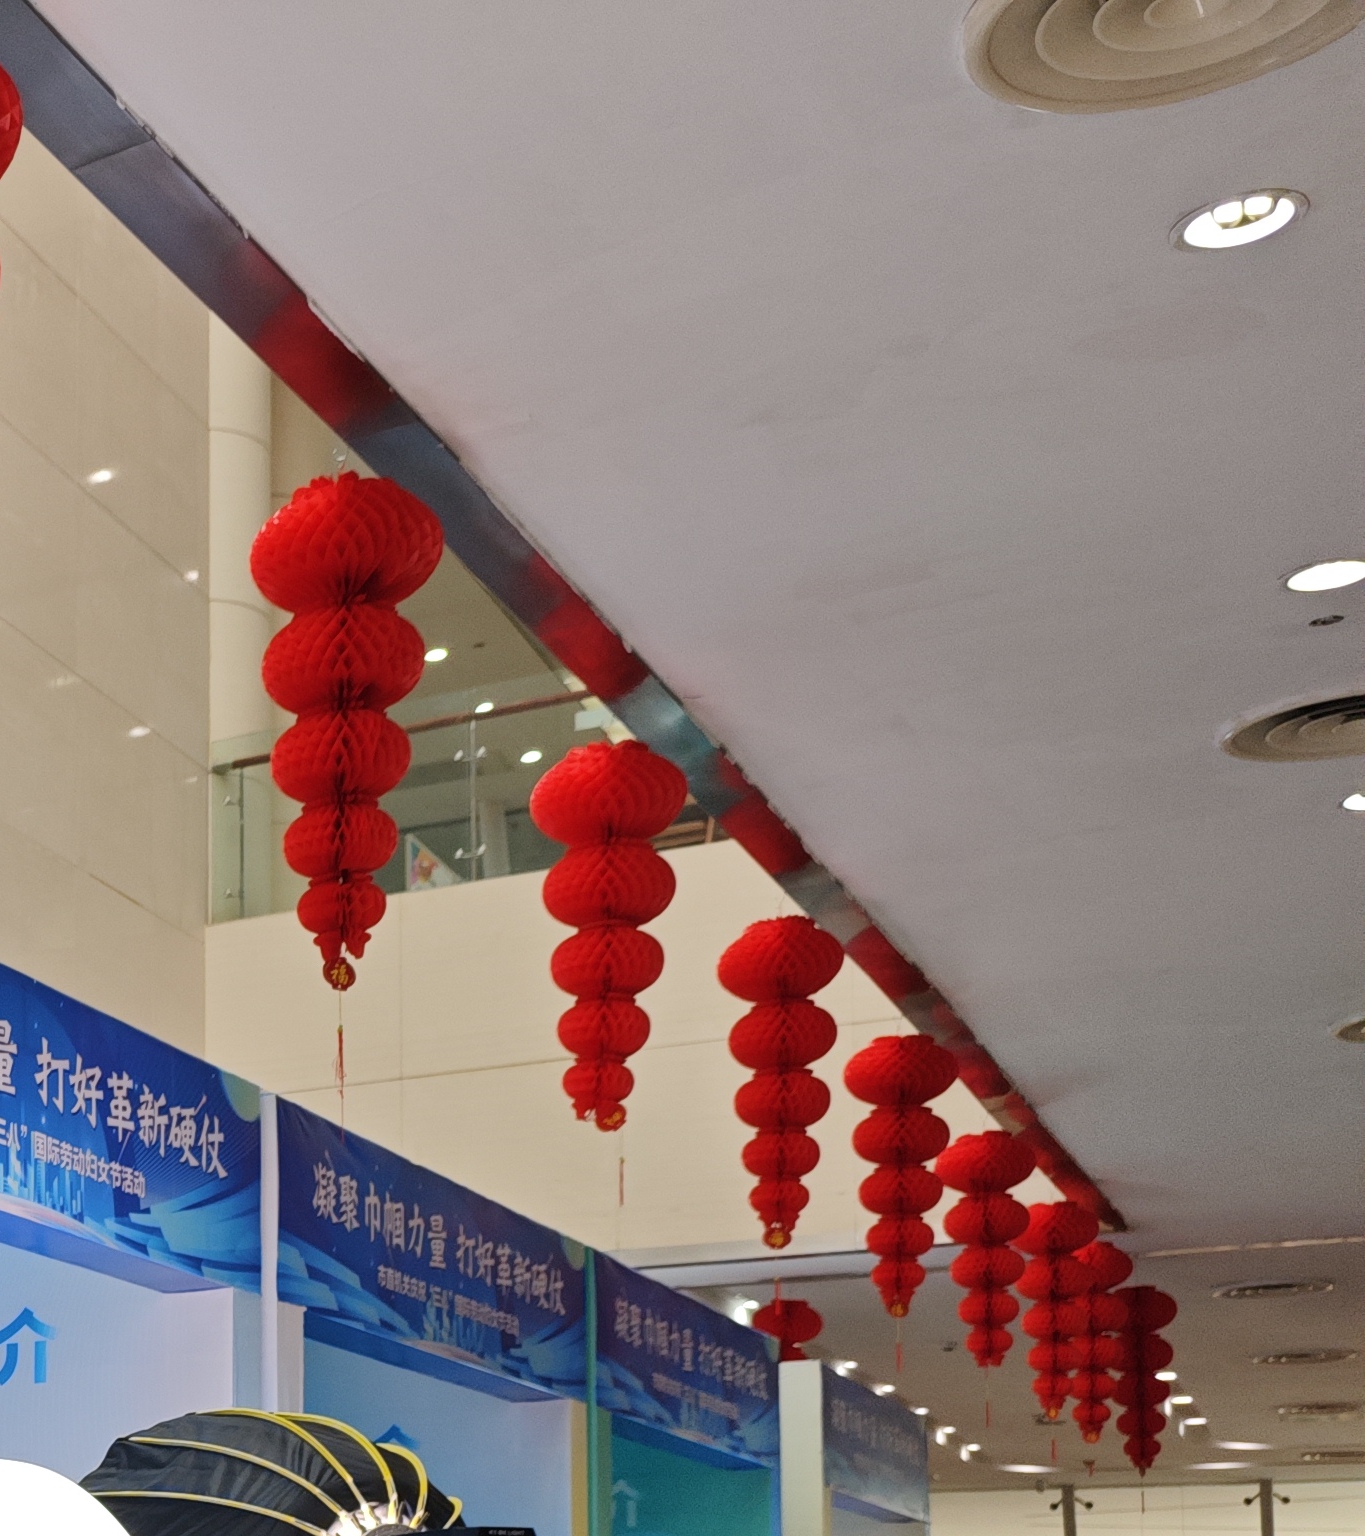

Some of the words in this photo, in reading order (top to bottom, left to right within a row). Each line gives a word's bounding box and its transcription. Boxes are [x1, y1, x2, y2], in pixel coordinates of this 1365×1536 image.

[330, 965, 350, 985] 福
[34, 1036, 229, 1180] 打好革新硬仗
[312, 1161, 361, 1234] 凝聚
